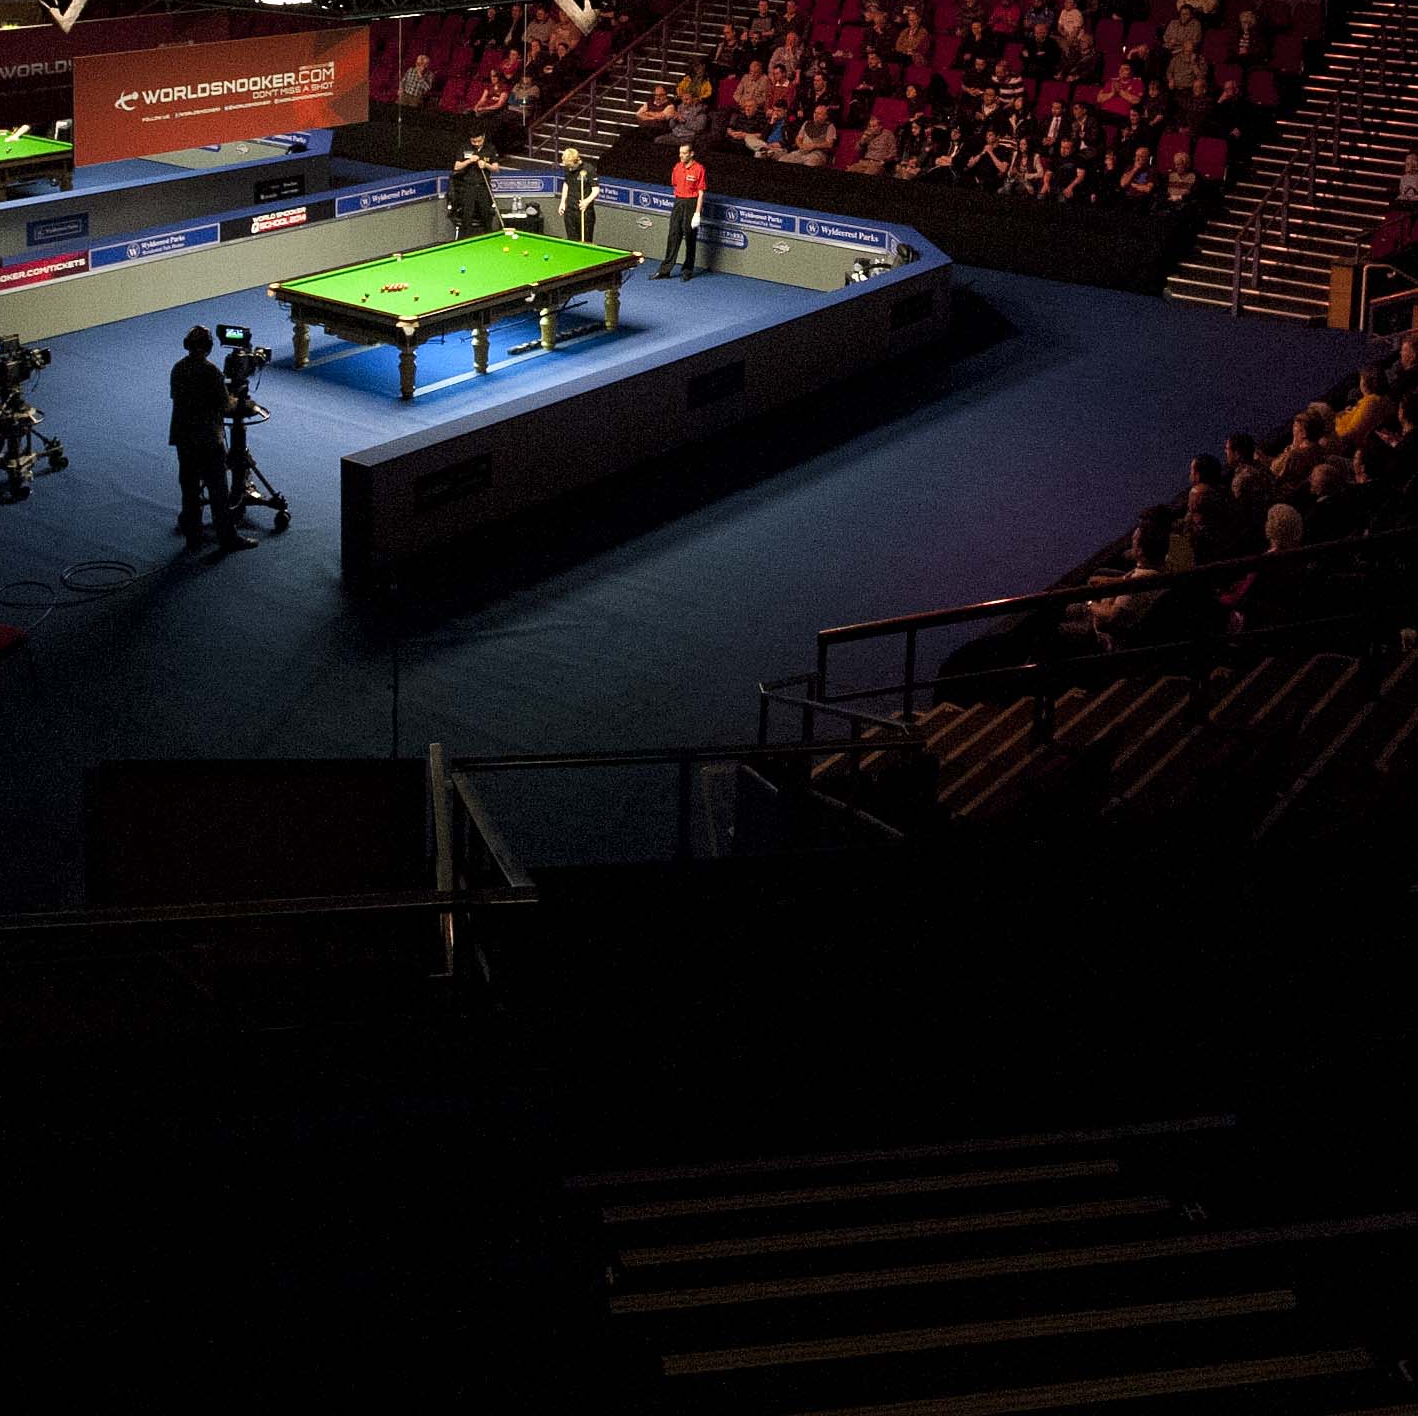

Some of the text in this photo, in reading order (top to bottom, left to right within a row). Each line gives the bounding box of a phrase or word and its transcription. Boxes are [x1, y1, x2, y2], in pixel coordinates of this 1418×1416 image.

[142, 68, 334, 105] WORLDSNOOKER.COM
[252, 88, 279, 99] DON'T
[280, 86, 301, 96] MISS
[302, 85, 310, 93] A
[311, 81, 333, 91] SHOT
[401, 188, 416, 197] Parks
[821, 225, 879, 243] Wyldecrest Parks
